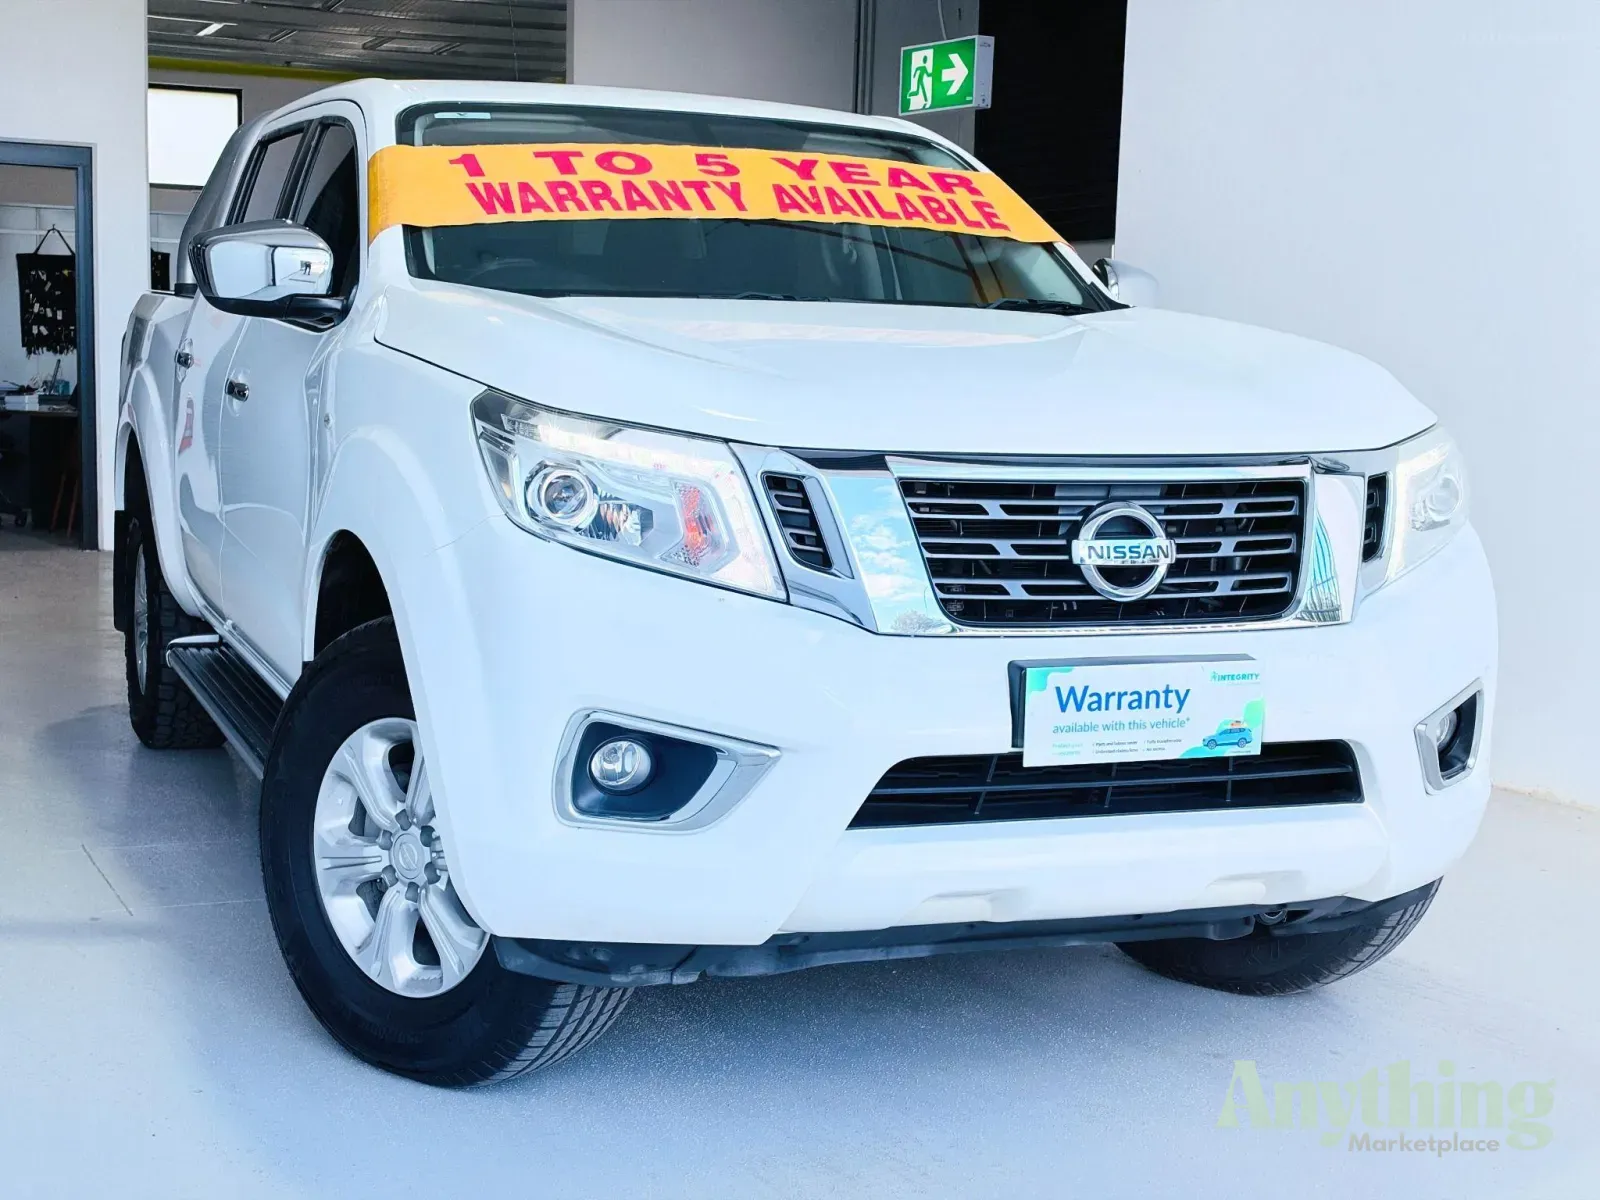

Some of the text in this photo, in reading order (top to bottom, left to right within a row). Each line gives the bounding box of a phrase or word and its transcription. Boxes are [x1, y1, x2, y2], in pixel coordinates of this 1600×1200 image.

[448, 150, 985, 198] 1 TO 5 YEAR
[465, 180, 1012, 232] WARRANTY AVAILABLE
[1087, 544, 1169, 560] NISSAN
[1217, 672, 1260, 682] INTEGRITY
[1055, 684, 1191, 714] Warranty
[1052, 721, 1099, 734] available
[1102, 719, 1125, 732] with
[1128, 718, 1147, 731] this
